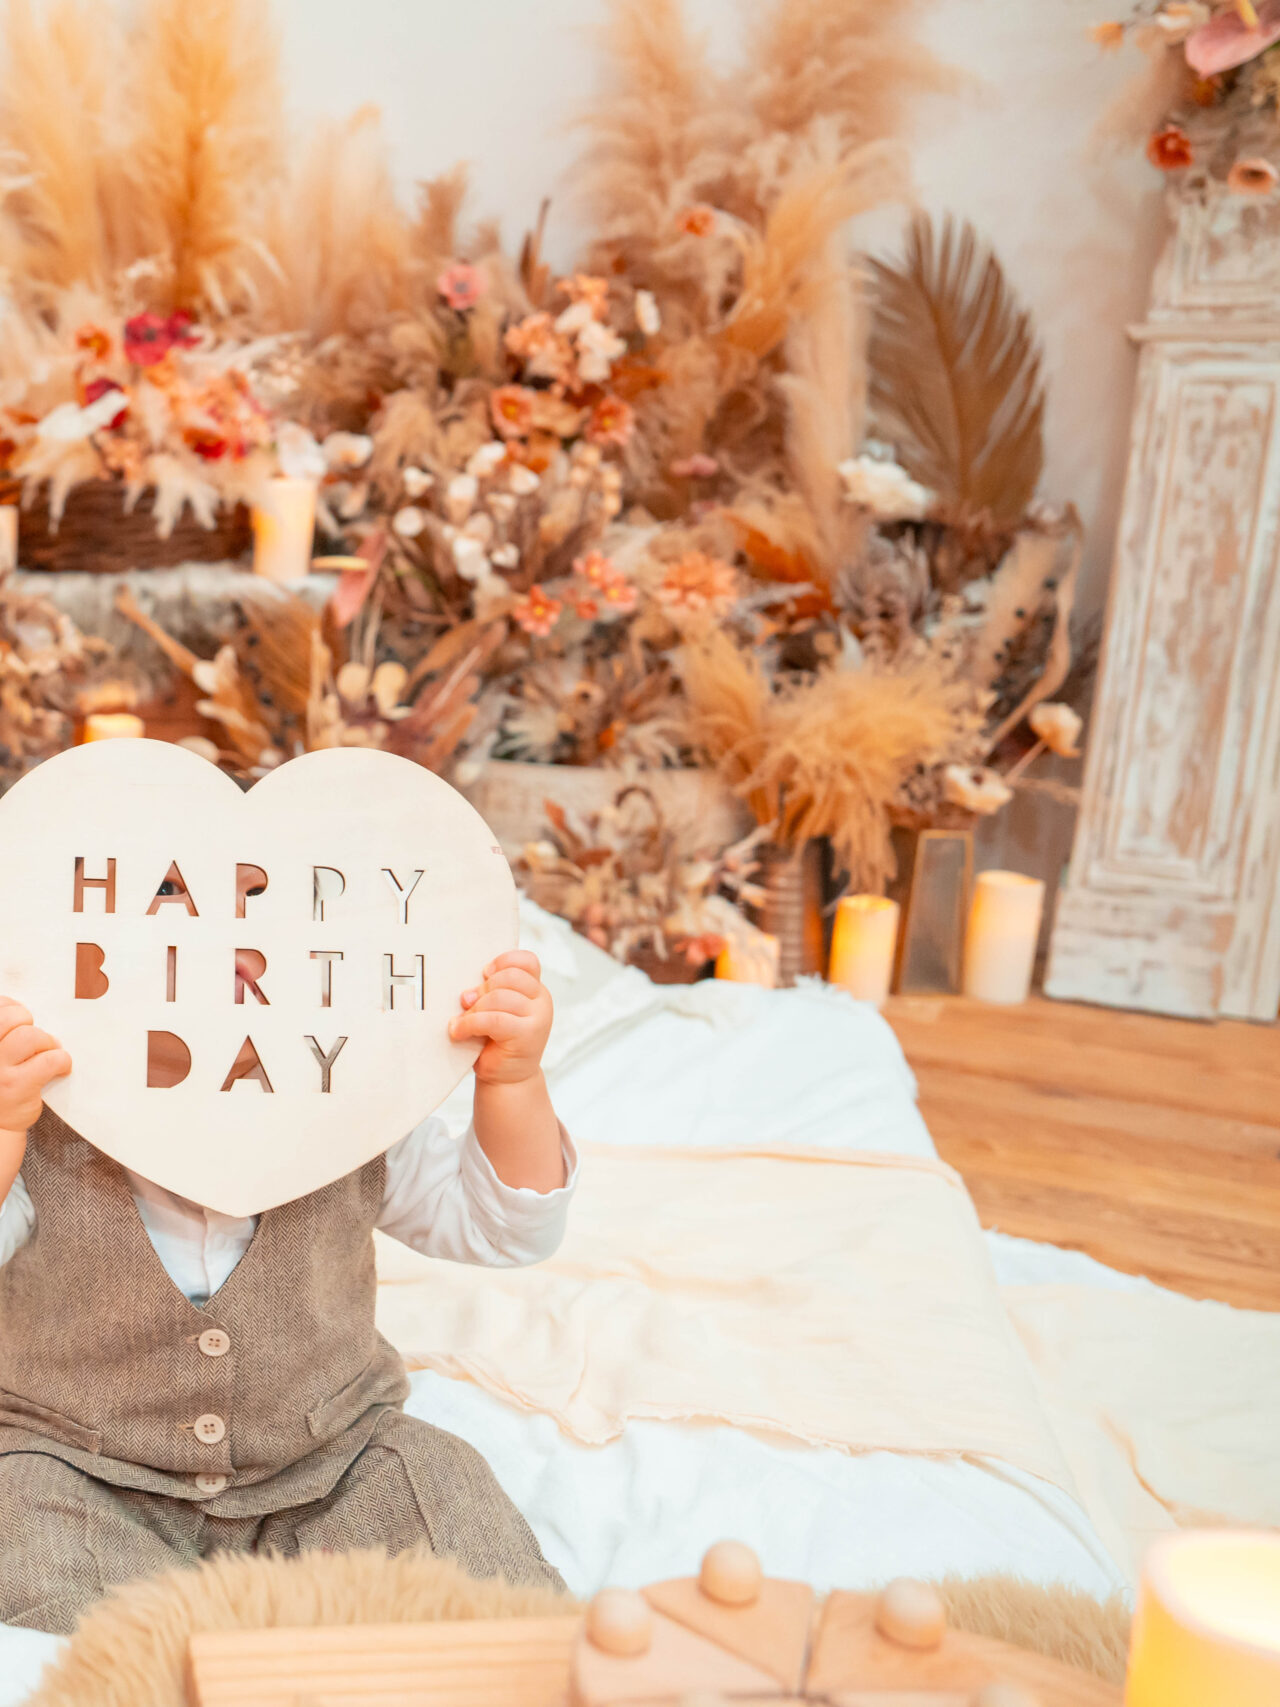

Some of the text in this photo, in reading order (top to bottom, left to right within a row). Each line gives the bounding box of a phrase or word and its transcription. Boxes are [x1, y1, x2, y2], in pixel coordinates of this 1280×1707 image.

[72, 856, 425, 924] HAPPY
[74, 942, 425, 1011] BIRTH
[146, 1030, 349, 1094] DAY
